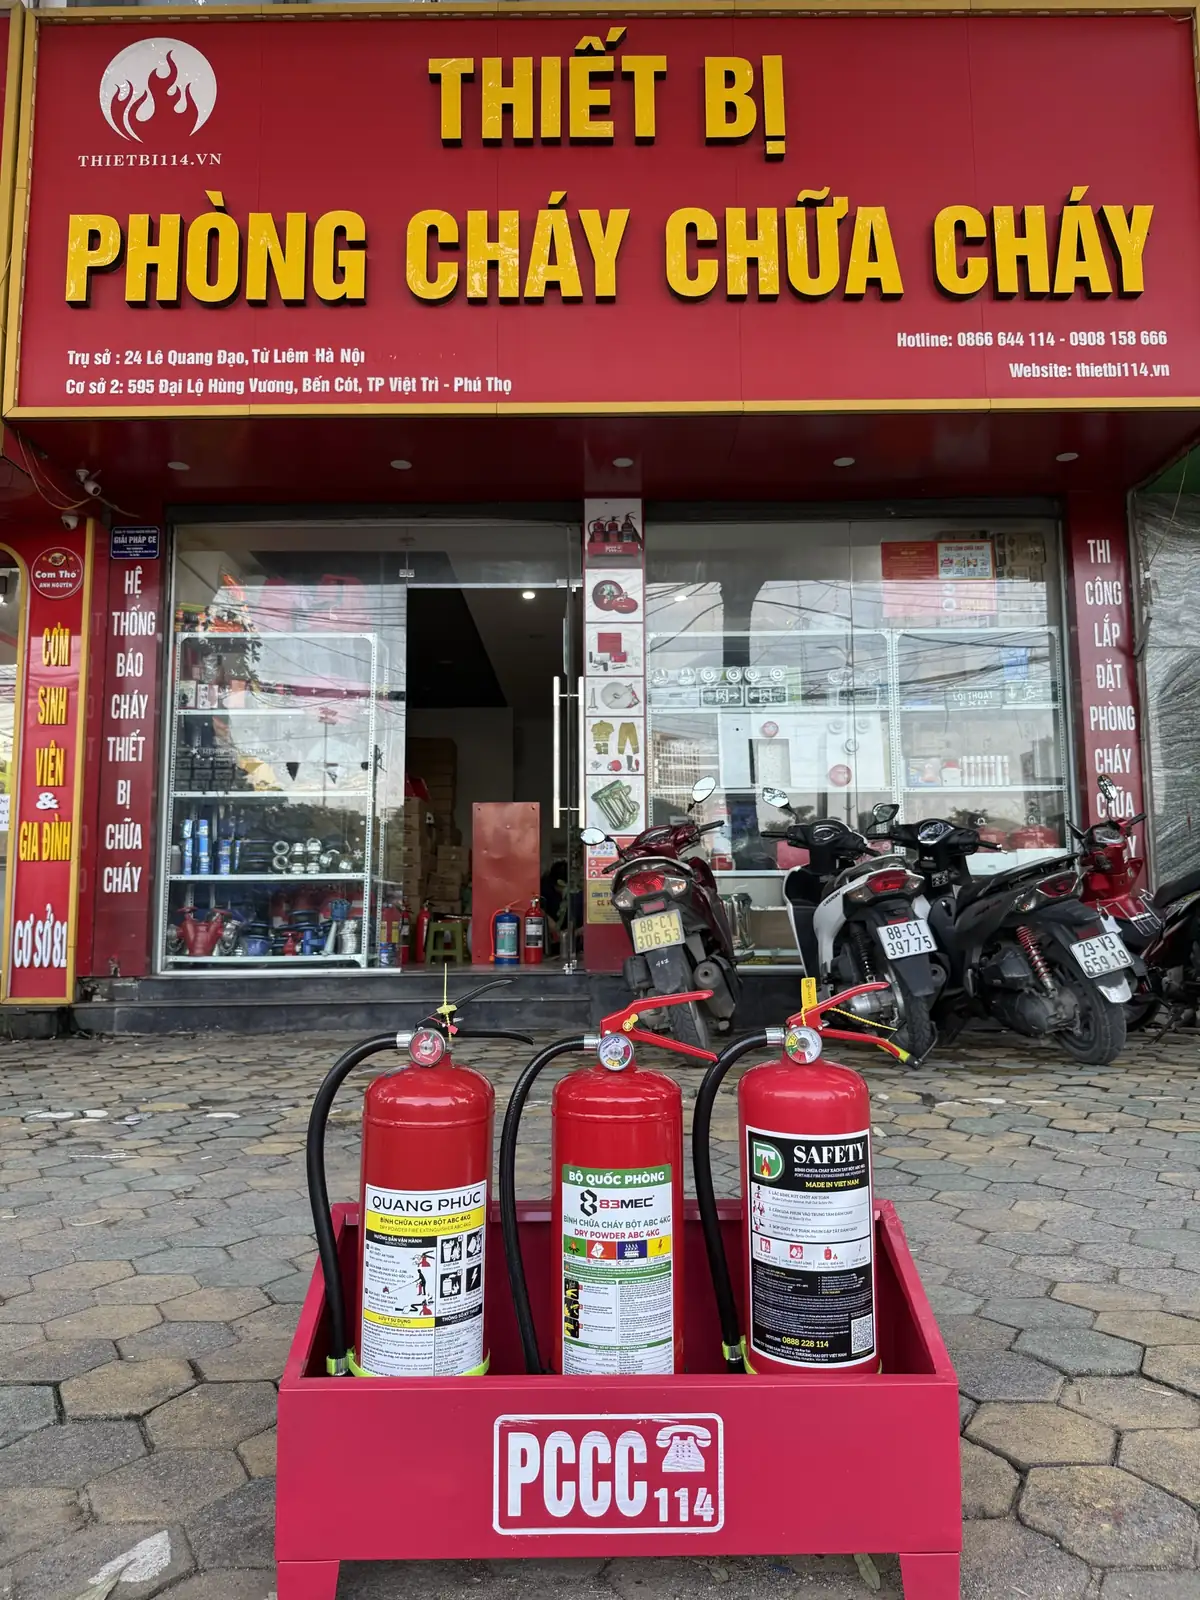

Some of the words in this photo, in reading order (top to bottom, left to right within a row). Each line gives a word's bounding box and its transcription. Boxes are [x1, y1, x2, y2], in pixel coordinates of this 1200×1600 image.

[428, 27, 667, 145] THIẾT
[704, 55, 786, 160] BỊ
[78, 153, 222, 167] THIETBI114.VN
[65, 190, 367, 305] PHÒNG
[405, 191, 630, 303] CHÁY
[665, 186, 904, 300] CHỮA
[933, 185, 1154, 298] CHÁY
[897, 332, 952, 347] Hotline:
[957, 332, 993, 346] 0866
[997, 332, 1025, 346] 644
[1029, 332, 1055, 346] 114
[1069, 331, 1106, 346] 0908
[1109, 331, 1136, 346] 158
[1140, 330, 1168, 345] 666
[67, 350, 89, 368] Trụ
[93, 348, 111, 365] sở
[124, 350, 142, 365] 24
[146, 349, 163, 365] Lê
[168, 350, 213, 366] Quang
[217, 349, 249, 368] Đạo,
[252, 347, 270, 364] Từ
[273, 348, 308, 364] Liêm
[315, 347, 334, 364] Hà
[340, 348, 365, 366] Nội
[1009, 363, 1072, 378] Website:
[1076, 362, 1170, 377] thietbi114.vn
[66, 379, 85, 394] Cơ
[88, 378, 106, 394] sở
[110, 379, 123, 394] 2:
[127, 379, 154, 394] 595
[158, 379, 182, 397] Đại
[187, 378, 204, 397] Lộ
[208, 378, 244, 396] Hùng
[249, 376, 298, 395] Vương,
[302, 375, 330, 393] Bến
[334, 376, 362, 394] Cót,
[367, 376, 384, 392] TP
[389, 376, 416, 395] Việt
[420, 376, 439, 392] Trì
[453, 375, 482, 392] Phú
[485, 376, 512, 395] Thọ
[148, 535, 157, 544] CE
[1087, 539, 1111, 564] THI
[124, 565, 142, 595] HỆ
[1085, 578, 1121, 606] CÔNG
[112, 607, 155, 637] THỐNG
[1095, 613, 1120, 648] LẮP
[42, 622, 72, 667] CƠM
[116, 648, 144, 677] BÁO
[1096, 662, 1122, 692] ĐẶT
[37, 686, 67, 725] SINH
[111, 690, 148, 719] CHÁY
[1090, 700, 1136, 731] PHÒNG
[107, 729, 146, 763] THIẾT
[1094, 743, 1131, 773] CHÁY
[35, 740, 65, 787] VIÊN
[36, 792, 59, 811] &
[117, 779, 131, 810] BỊ
[19, 821, 39, 862] GIA
[41, 813, 72, 861] ĐÌNH
[105, 819, 142, 850] CHỮA
[103, 862, 141, 893] CHÁY
[14, 913, 34, 968] CƠ
[33, 903, 54, 968] SỞ
[52, 920, 67, 968] 81
[640, 915, 673, 933] 88-C1
[886, 922, 922, 940] 88-C1
[637, 928, 681, 949] 306.53
[887, 935, 932, 956] 397.75
[1078, 936, 1116, 957] 29-V3
[1083, 949, 1129, 976] 659.19
[793, 1142, 864, 1164] SAFETY
[569, 1171, 583, 1185] BỘ
[586, 1171, 621, 1186] QUỐC
[624, 1169, 665, 1184] PHÒNG
[372, 1195, 433, 1212] QUANG
[438, 1191, 481, 1212] PHÚC
[380, 1216, 394, 1225] BÌNH
[394, 1218, 413, 1226] CHỮA
[413, 1218, 431, 1226] CHÁY
[433, 1218, 447, 1227] BỘT
[564, 1214, 578, 1225] BÌNH
[578, 1216, 600, 1228] CHỮA
[601, 1220, 624, 1229] CHÁY
[625, 1219, 642, 1230] BỘT
[643, 1218, 658, 1227] ABC
[659, 1215, 671, 1224] 4KG
[574, 1228, 589, 1237] DRY
[590, 1231, 626, 1240] POWDER
[627, 1230, 644, 1239] ABC
[645, 1228, 660, 1237] 4KG
[782, 1336, 800, 1346] 0888
[801, 1339, 815, 1347] 228
[816, 1340, 829, 1348] 114
[507, 1430, 648, 1517] PCCC
[654, 1487, 714, 1522] 114
